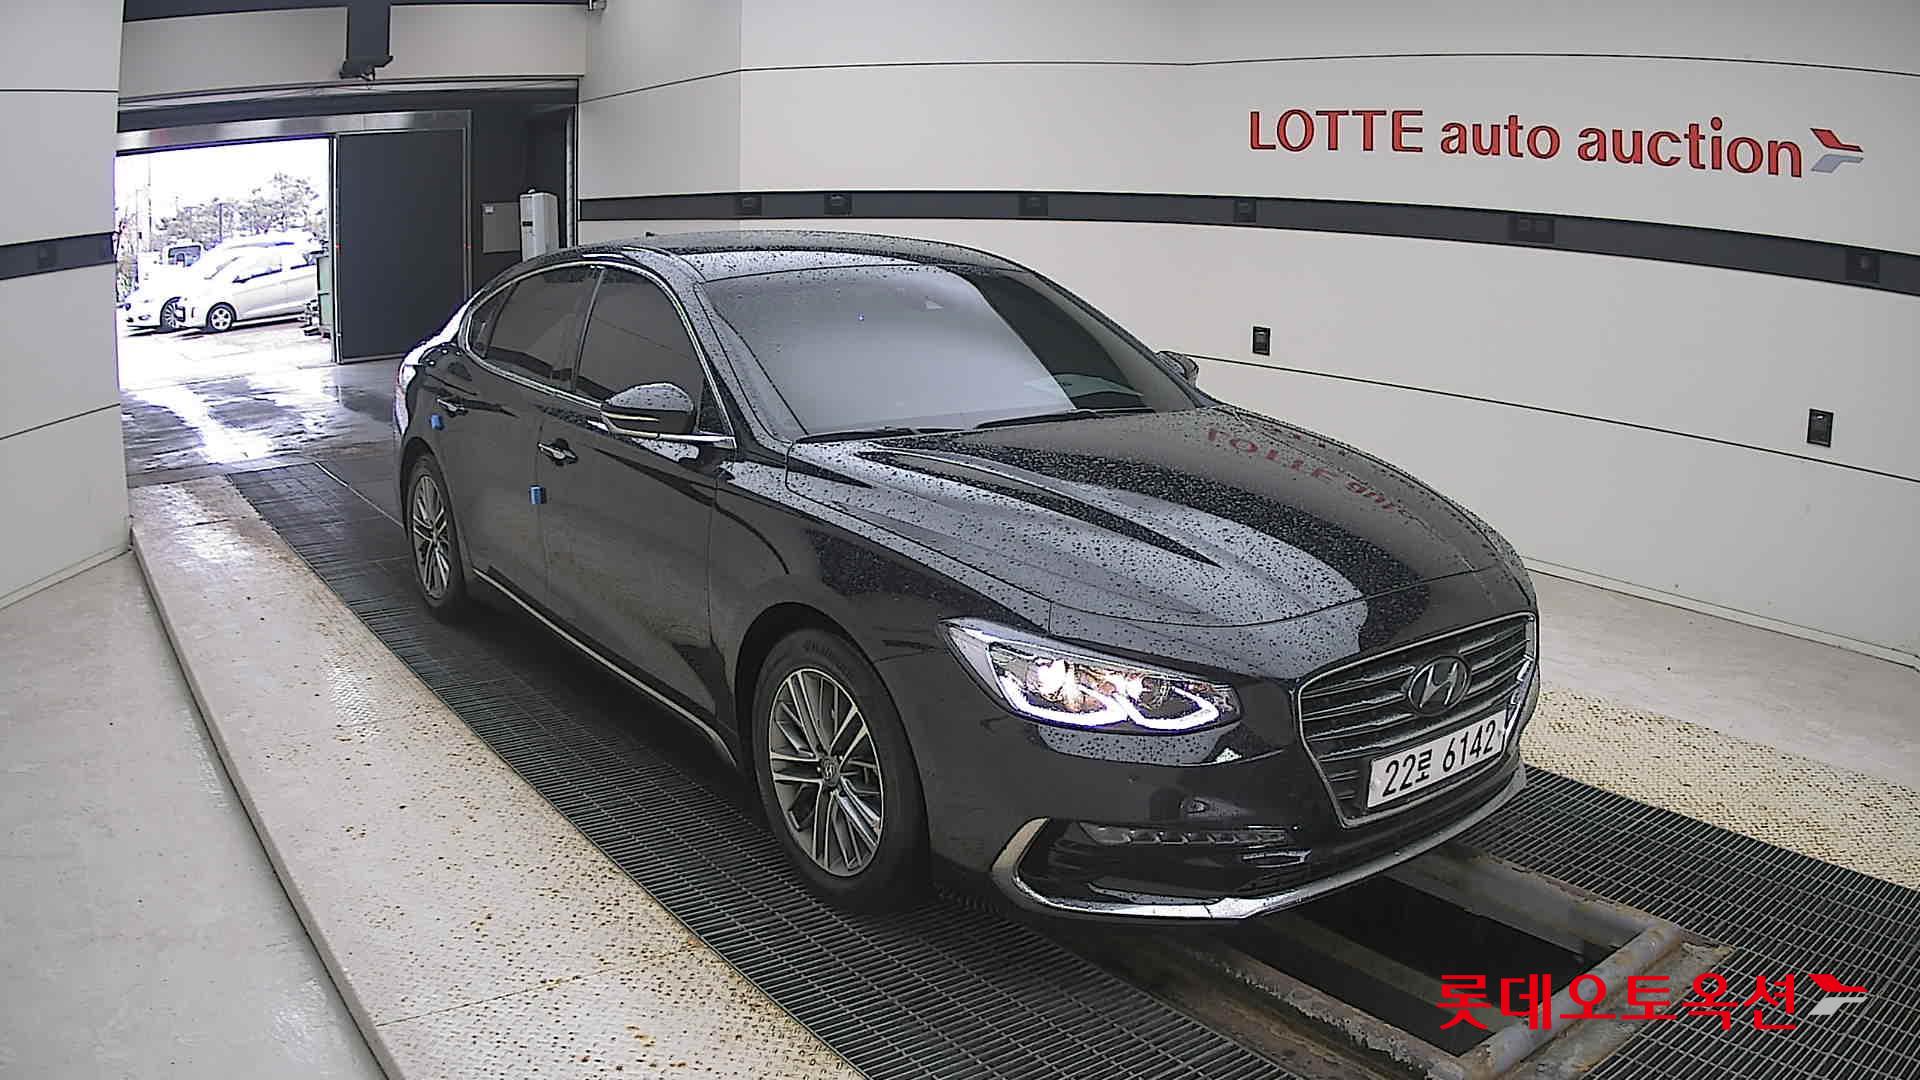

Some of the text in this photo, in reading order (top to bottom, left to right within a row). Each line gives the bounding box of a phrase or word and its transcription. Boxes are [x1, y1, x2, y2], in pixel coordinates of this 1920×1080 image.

[1249, 109, 1803, 178] LOTTE auto auction
[1382, 719, 1497, 798] 22로 6142
